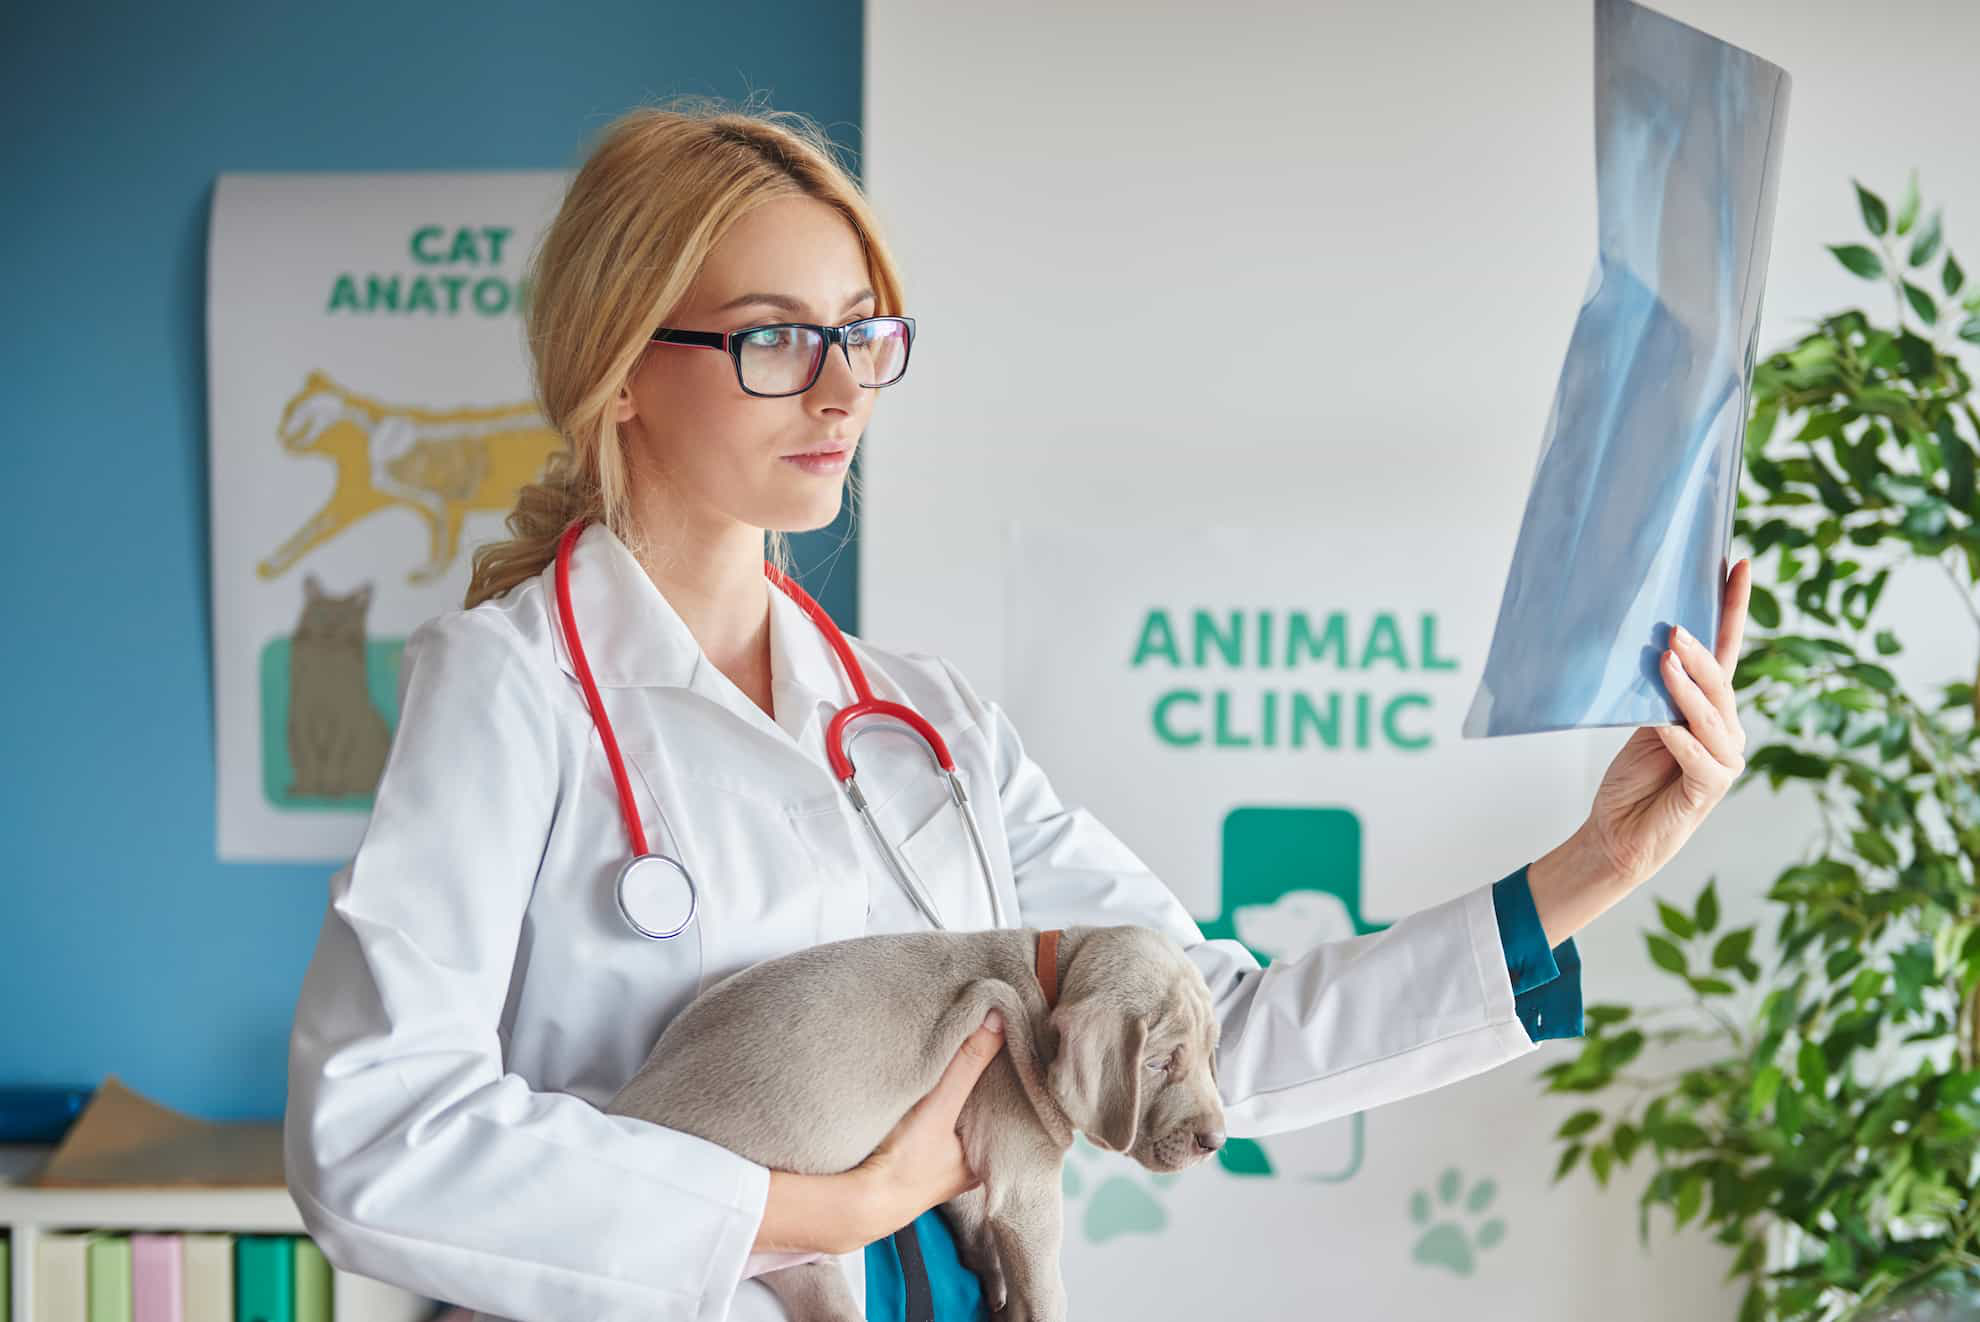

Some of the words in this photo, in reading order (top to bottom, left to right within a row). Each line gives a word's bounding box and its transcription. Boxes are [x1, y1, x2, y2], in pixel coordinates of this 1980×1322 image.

[410, 226, 513, 265] CAT
[327, 273, 530, 316] ANATO
[1130, 608, 1460, 671] ANIMAL
[1151, 689, 1435, 751] CLINIC
